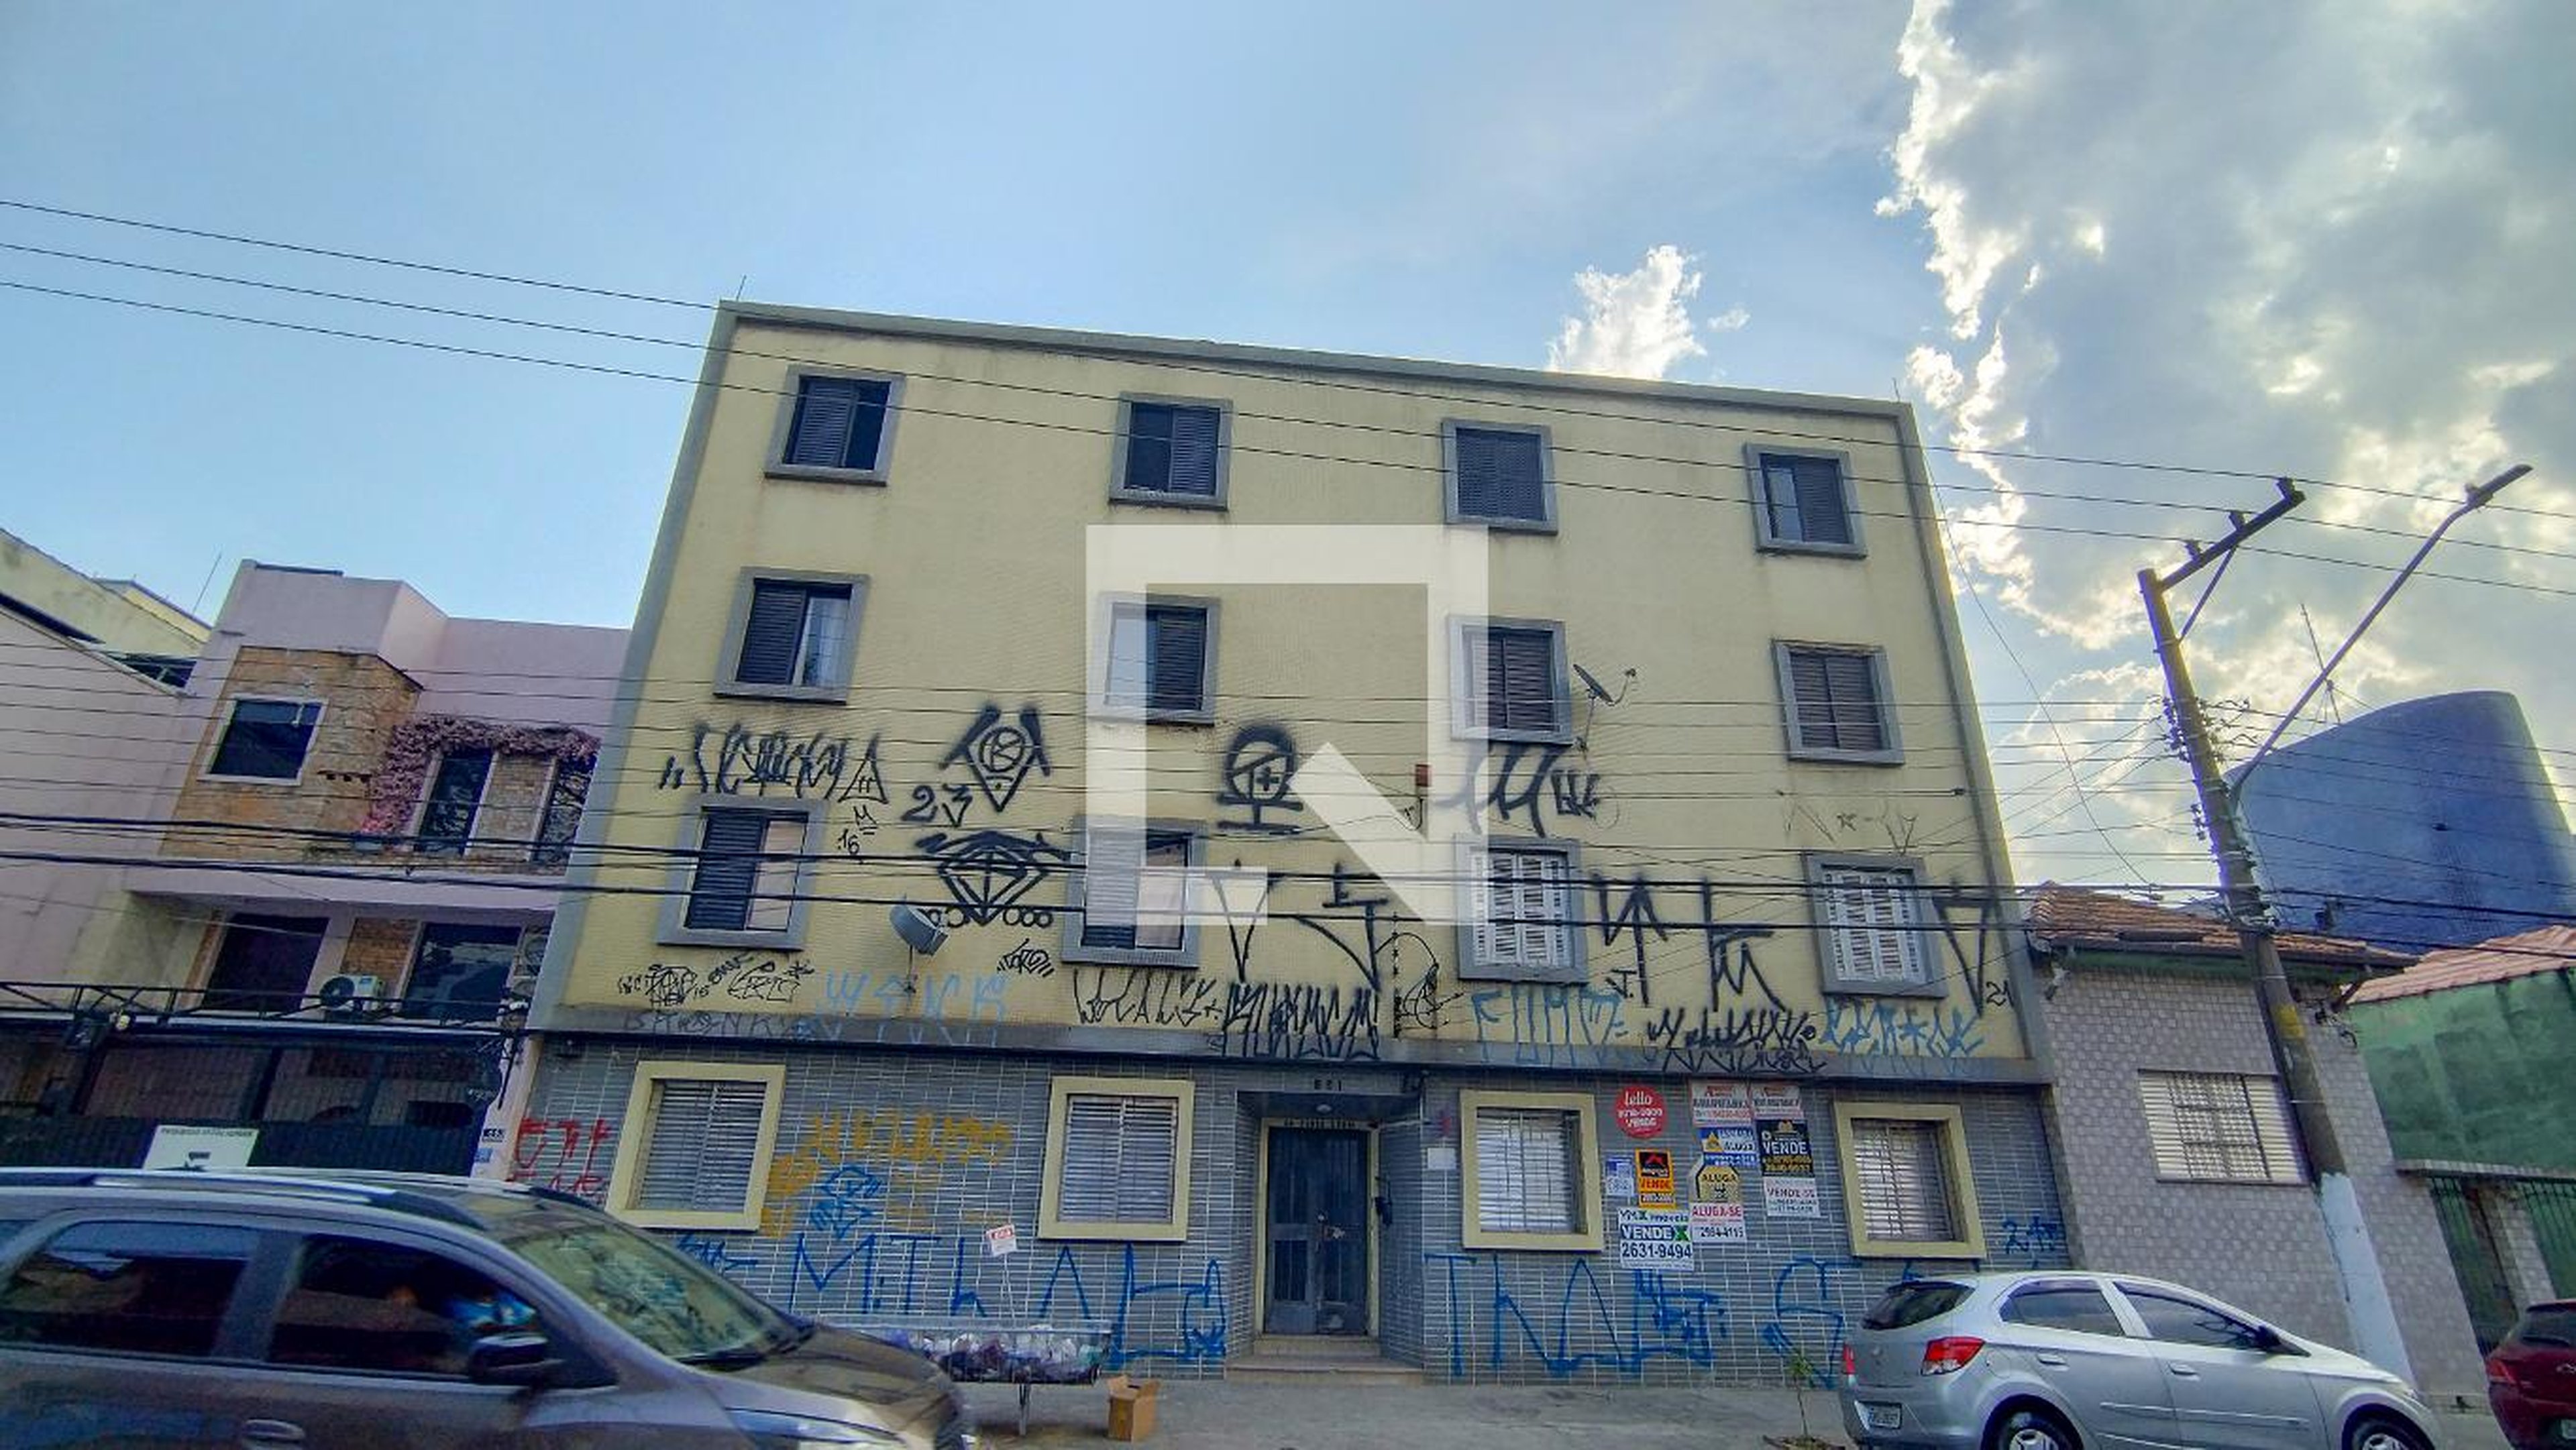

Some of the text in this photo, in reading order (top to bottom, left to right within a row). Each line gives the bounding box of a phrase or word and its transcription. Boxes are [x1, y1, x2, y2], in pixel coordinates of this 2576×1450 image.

[1762, 1141, 1808, 1154] VENDE
[1702, 1173, 1737, 1182] ALUGA
[1622, 1242, 1692, 1258] 2631-9494
